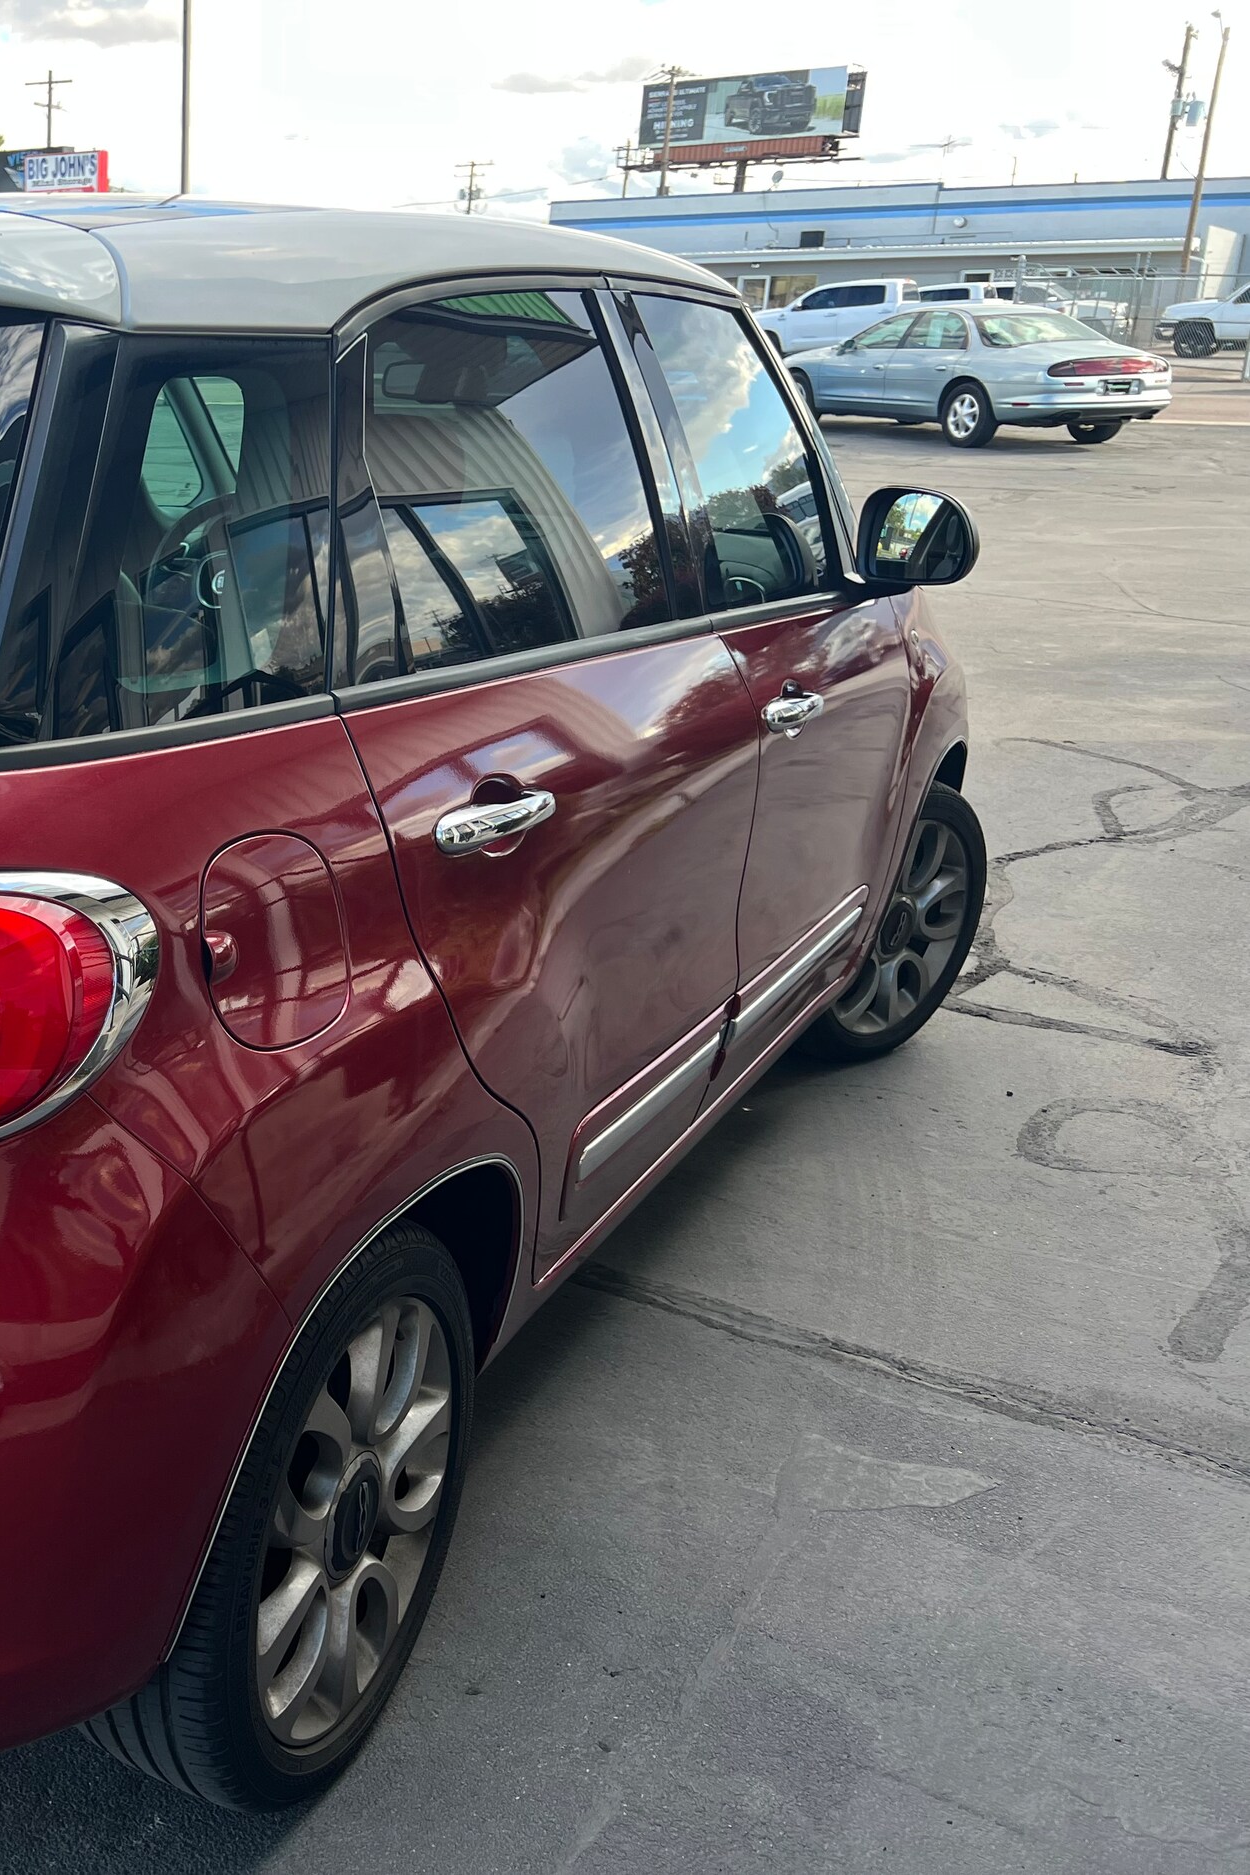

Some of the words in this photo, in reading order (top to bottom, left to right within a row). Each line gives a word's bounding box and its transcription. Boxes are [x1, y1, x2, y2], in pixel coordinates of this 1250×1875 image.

[28, 158, 48, 180] BIG
[52, 154, 97, 178] JOHN'S
[236, 1518, 264, 1632] BRAVURIS
